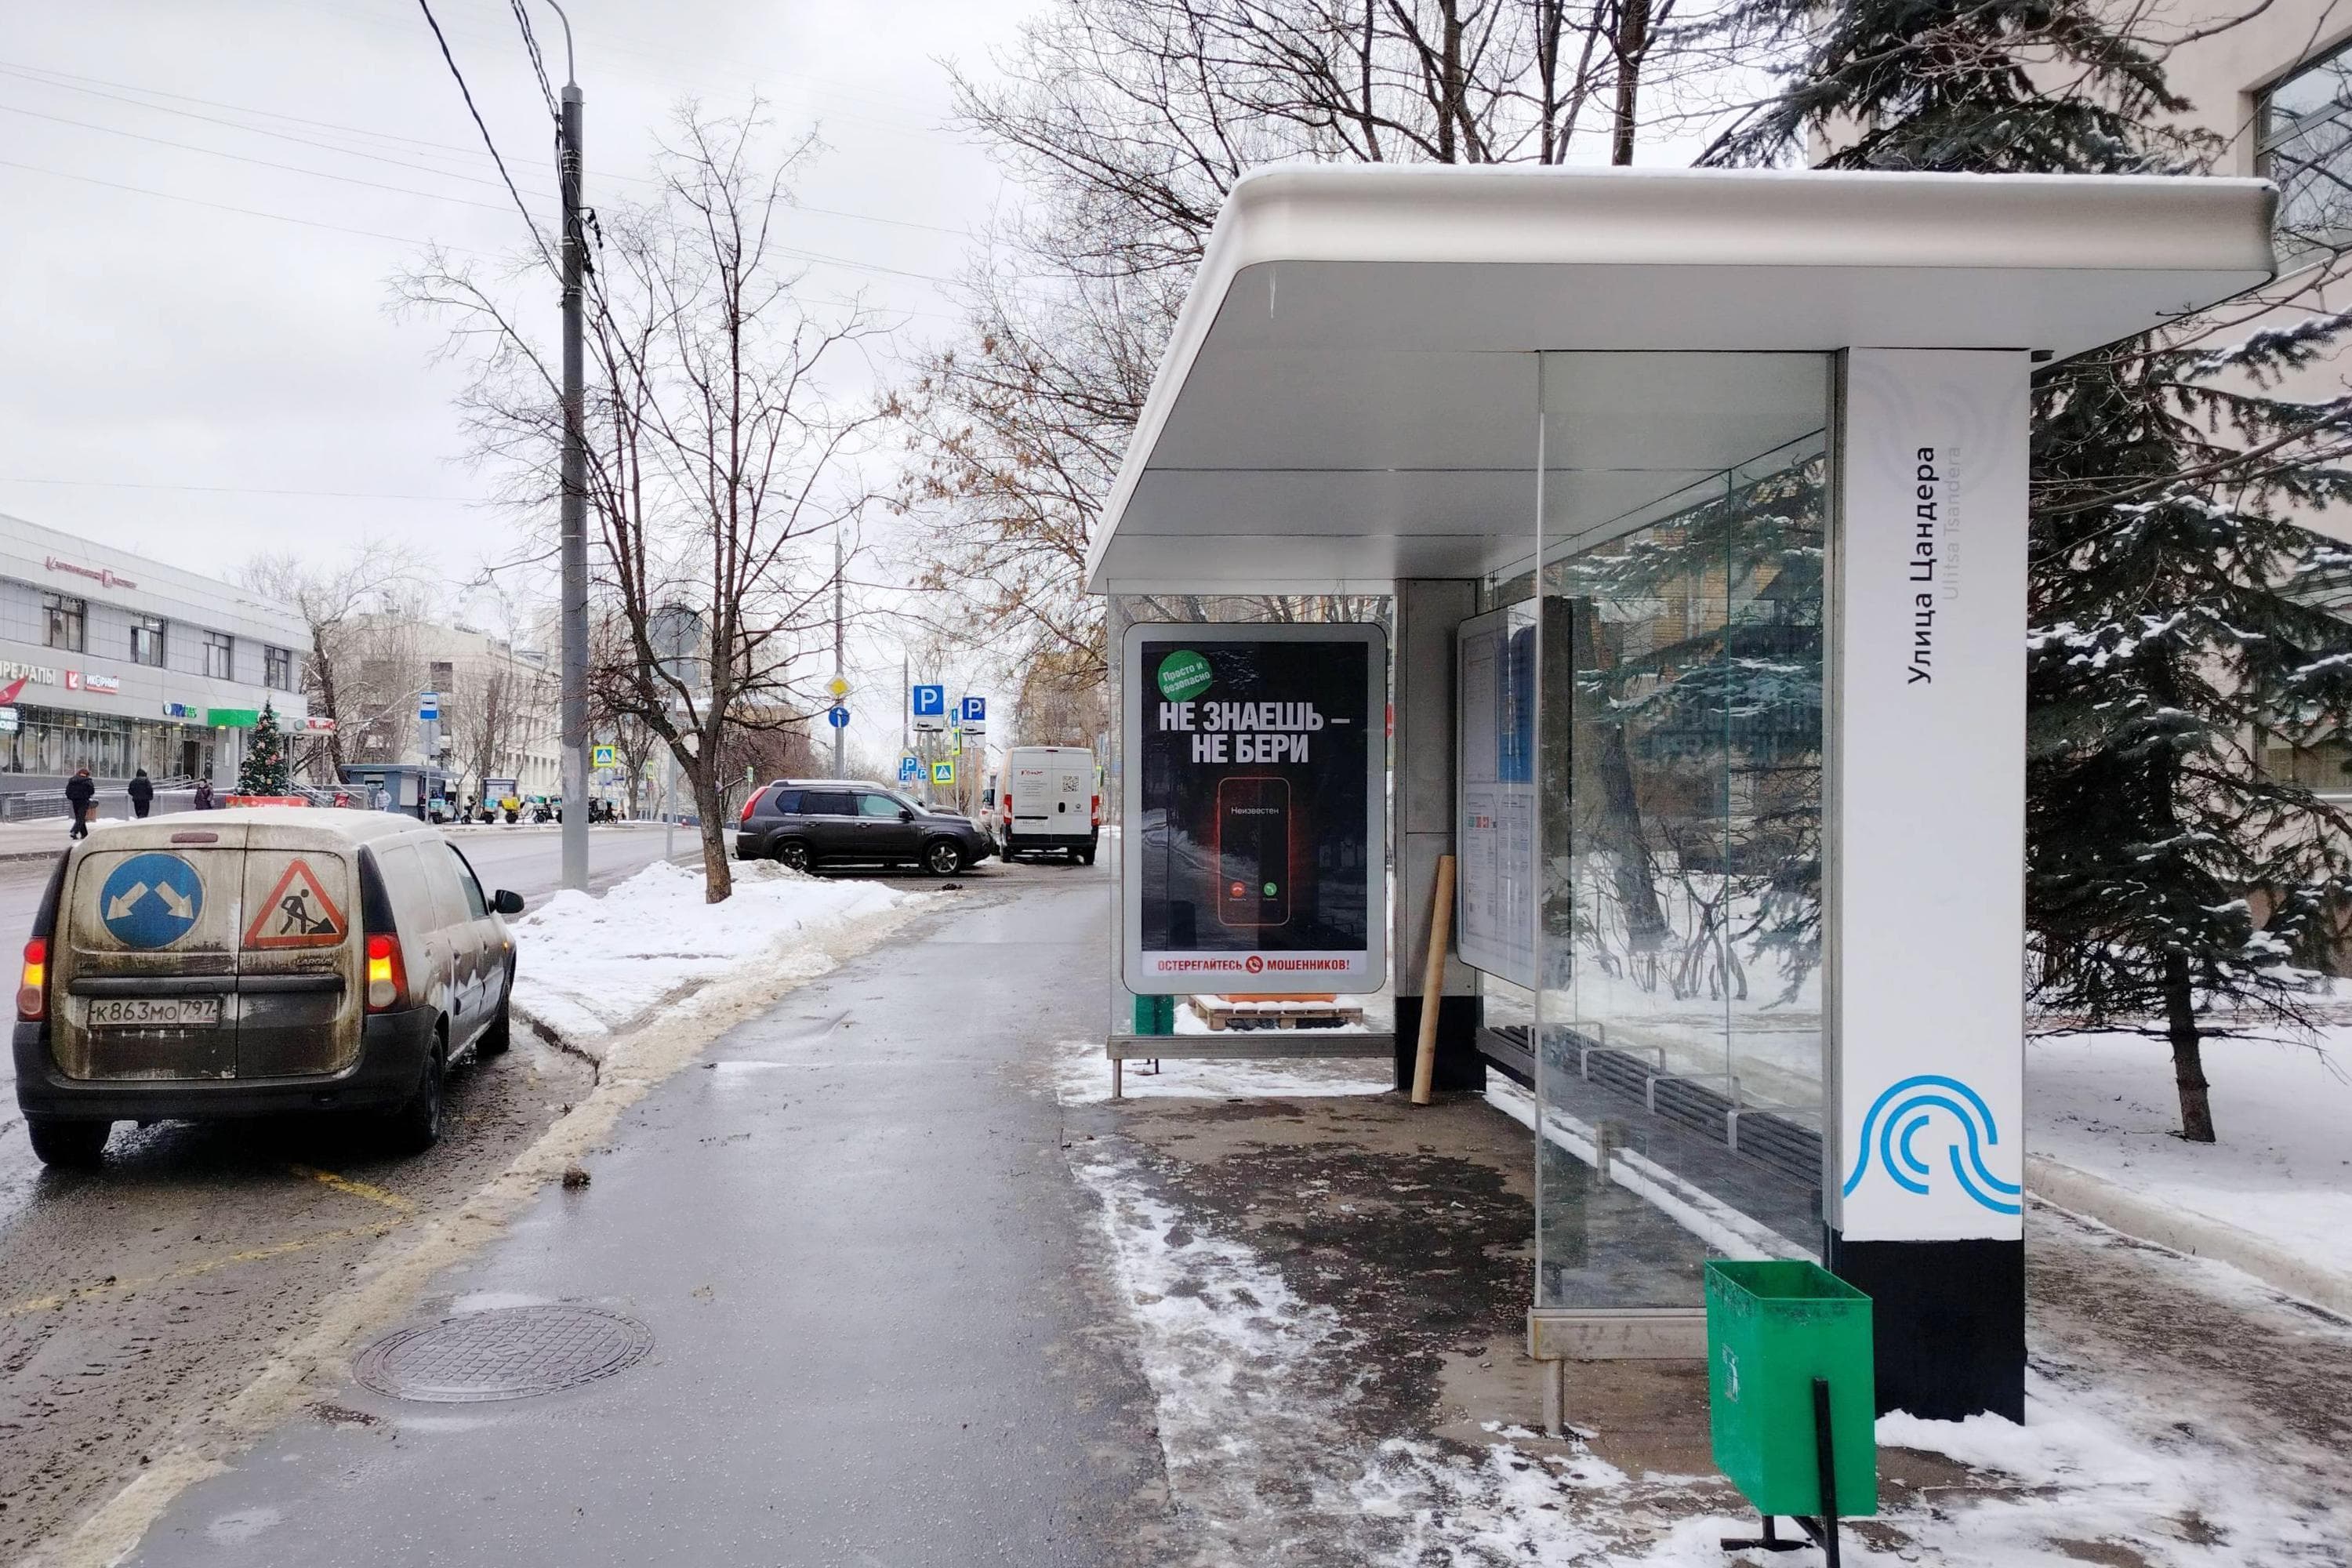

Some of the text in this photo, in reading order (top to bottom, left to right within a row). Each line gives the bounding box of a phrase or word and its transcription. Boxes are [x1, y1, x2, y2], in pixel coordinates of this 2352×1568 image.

[1943, 447, 1960, 600] Ulitsa Tsandera
[1908, 447, 1940, 684] Улица Цандера
[1162, 662, 1203, 682] Просто и
[1163, 671, 1210, 694] безопасно
[920, 688, 938, 712] P
[968, 699, 982, 718] P
[1160, 702, 1196, 731] НЕ
[1203, 702, 1324, 731] ЗНАЕШЬ
[1192, 734, 1308, 763] НЕ БЕРИ
[906, 758, 915, 770] P
[1158, 958, 1350, 971] ОСТЕРЕГАЙТЕСЬ МОШЕННИКОВ!
[182, 1000, 213, 1016] 797
